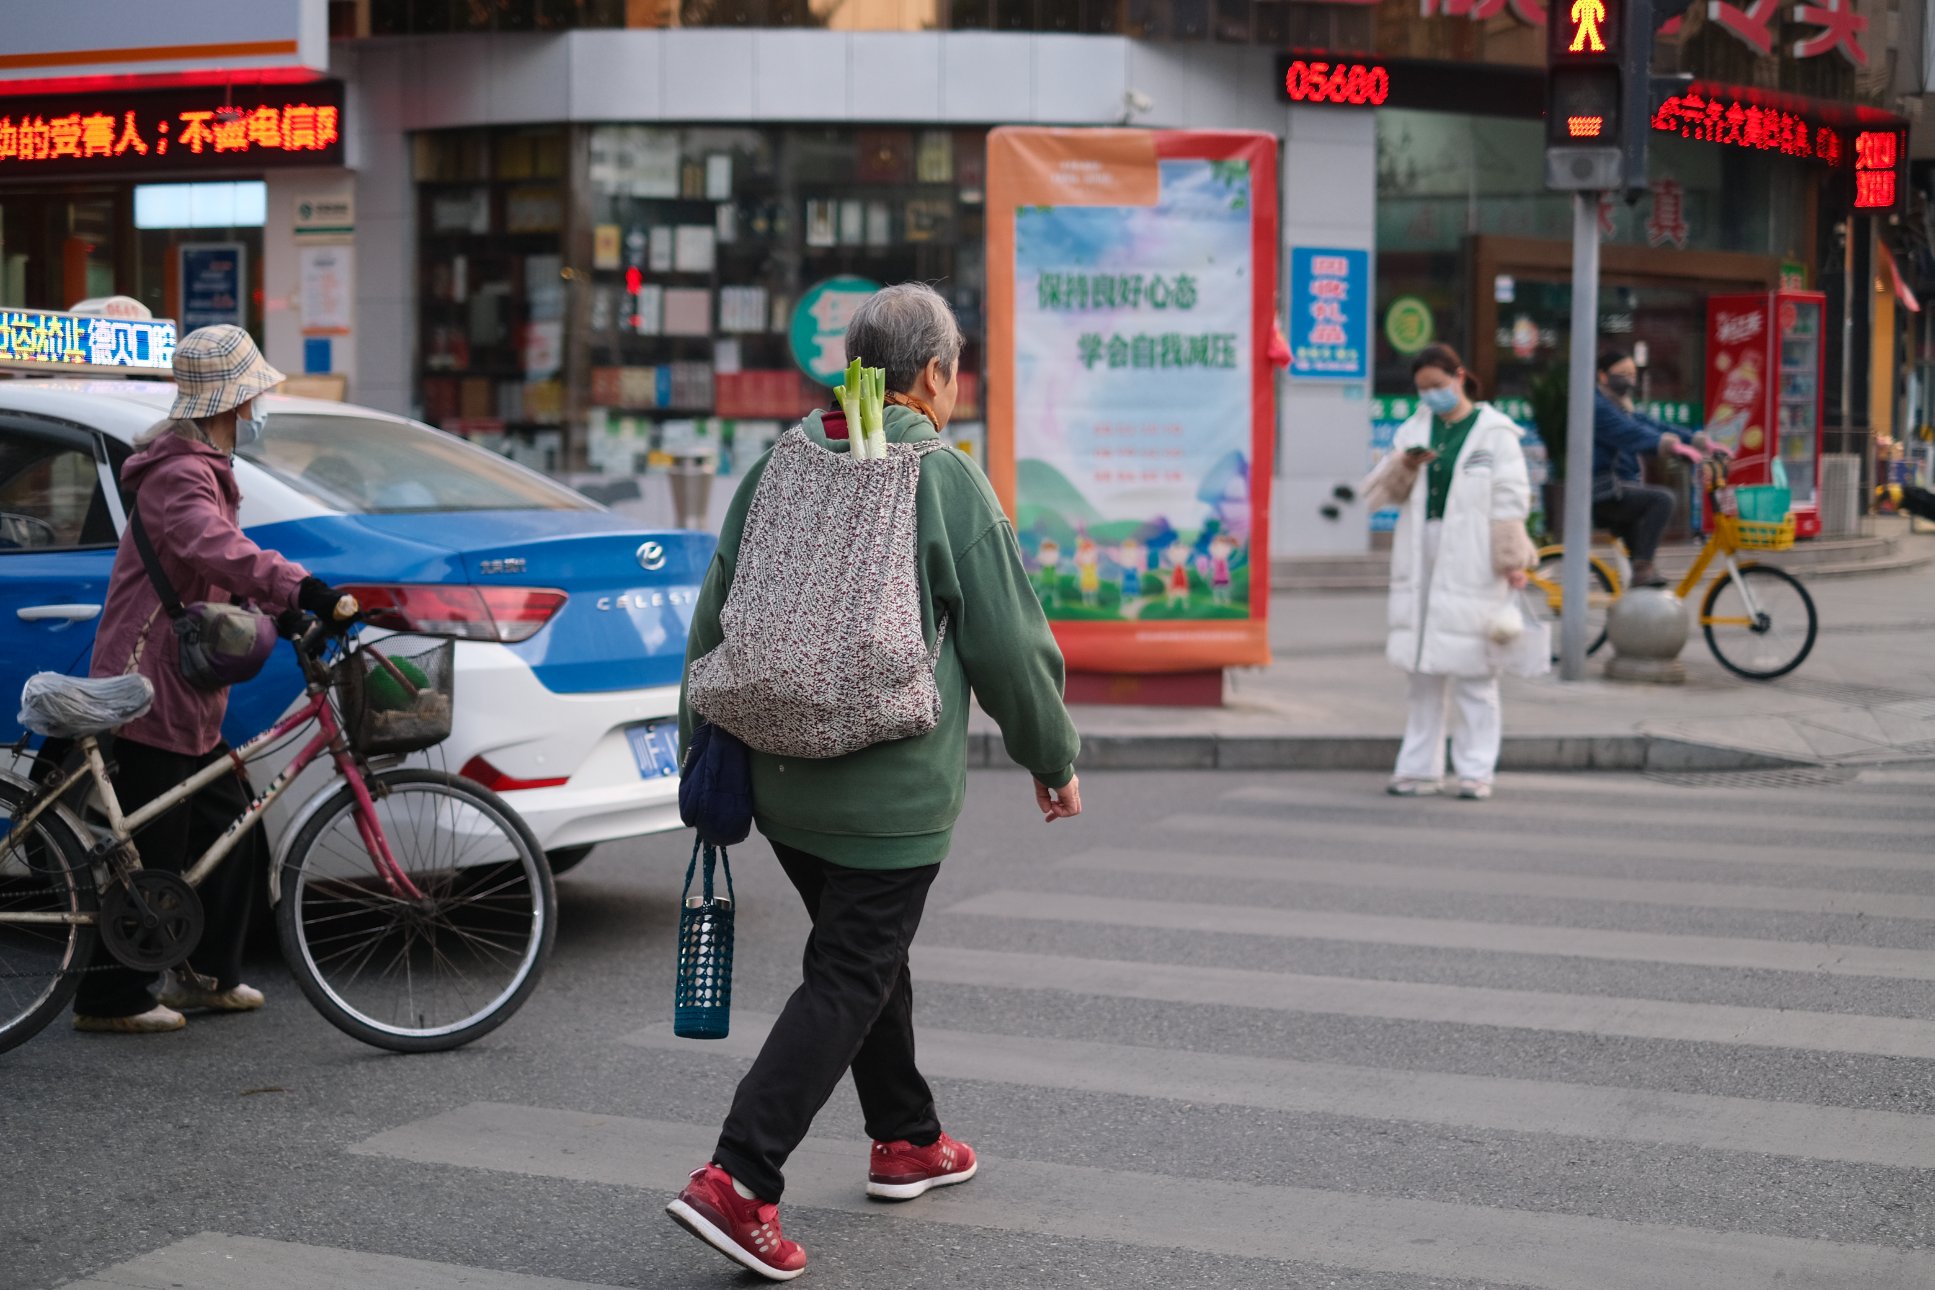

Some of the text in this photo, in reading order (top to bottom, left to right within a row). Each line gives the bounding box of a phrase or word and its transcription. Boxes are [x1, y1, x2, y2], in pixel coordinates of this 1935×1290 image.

[1285, 60, 1389, 105] 05680
[1037, 272, 1198, 312] 保持良好心态
[1077, 332, 1237, 370] 学会自我减压
